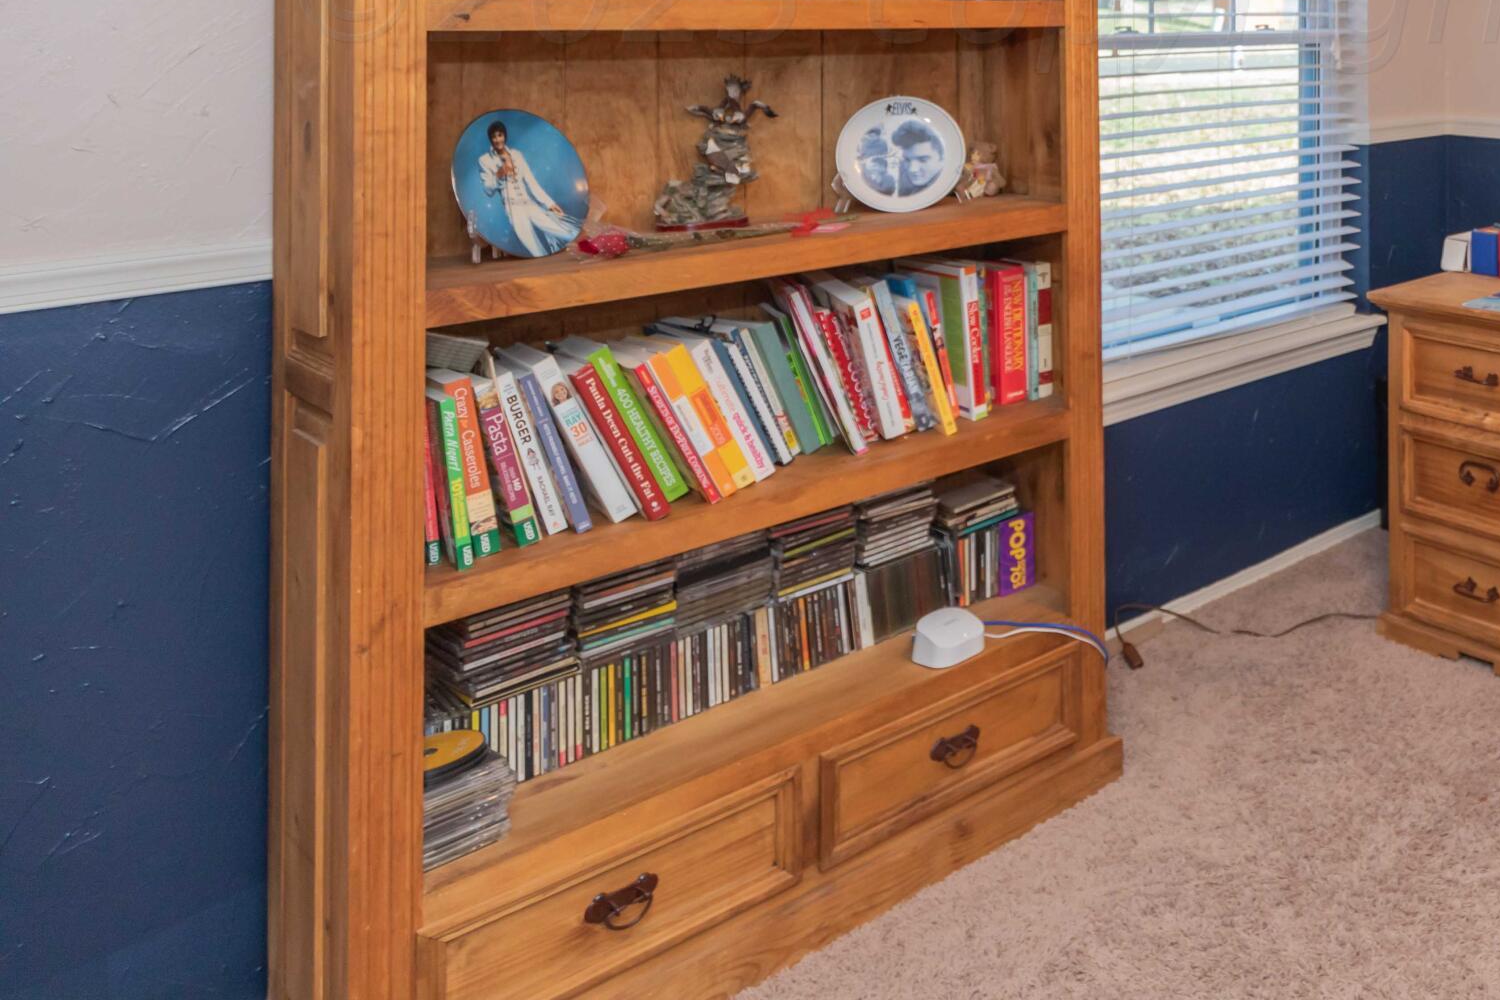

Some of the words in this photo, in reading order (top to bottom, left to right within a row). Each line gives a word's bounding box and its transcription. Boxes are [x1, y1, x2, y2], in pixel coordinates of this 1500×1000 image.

[968, 302, 979, 326] Slow
[454, 387, 469, 418] Crazy
[462, 430, 481, 489] Casseroles
[485, 412, 508, 456] Pasta
[506, 394, 532, 445] BURGER
[585, 377, 605, 410] Paula
[602, 409, 621, 439] Deen
[618, 438, 633, 464] Cuts
[631, 462, 644, 481] the
[640, 480, 655, 499] Fat
[617, 388, 633, 408] 400
[627, 407, 656, 450] HEALTHY
[650, 450, 676, 486] RECIPES
[462, 545, 473, 566] USED
[480, 533, 491, 553] USED
[1008, 518, 1026, 560] POP
